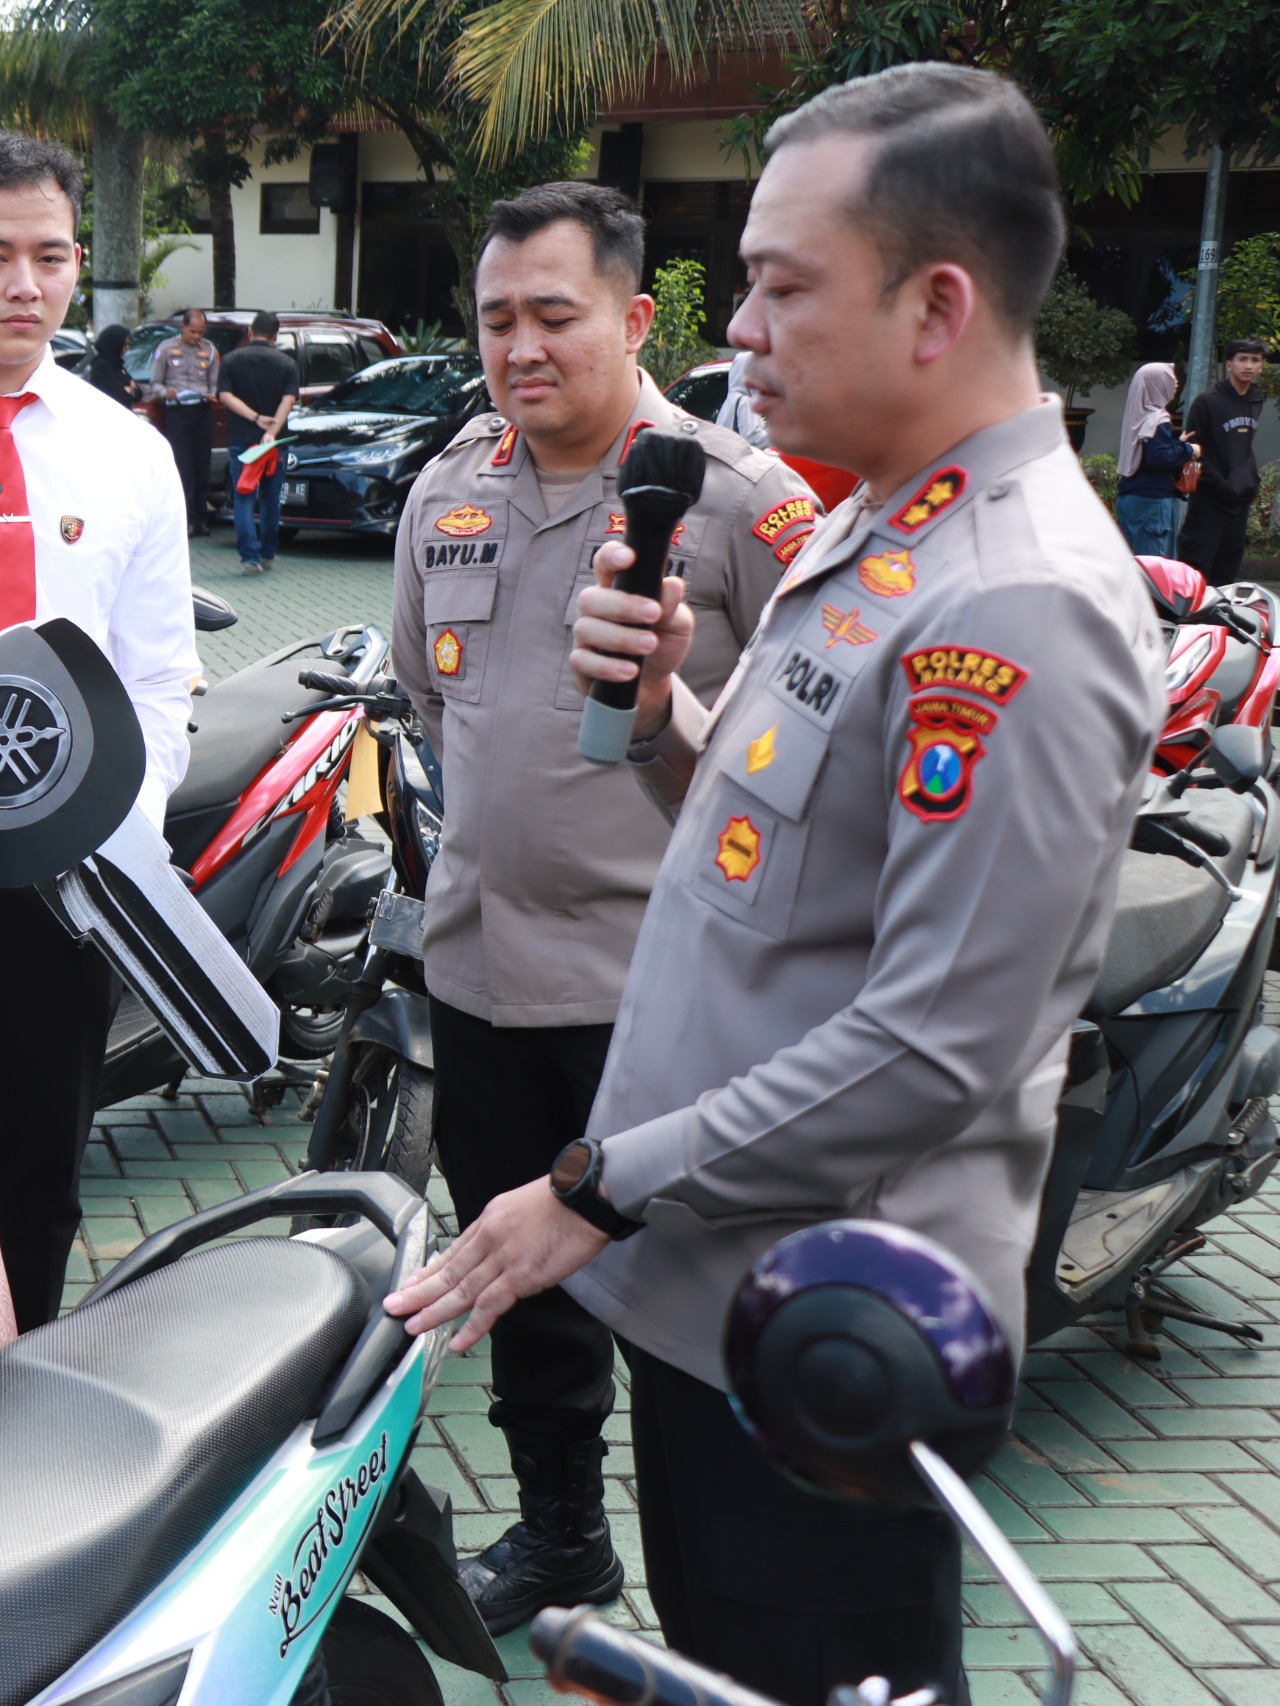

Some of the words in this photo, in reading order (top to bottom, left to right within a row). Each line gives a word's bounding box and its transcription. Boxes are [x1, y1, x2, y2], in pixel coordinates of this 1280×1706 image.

[1200, 248, 1216, 261] 169
[295, 483, 306, 496] KE
[758, 500, 812, 535] POLRES
[425, 542, 499, 569] BAYU.M
[911, 650, 1016, 687] POLRES
[919, 668, 1001, 695] MALANG
[776, 651, 841, 717] POLRI
[950, 704, 990, 726] TIMUR
[268, 1573, 283, 1616] New
